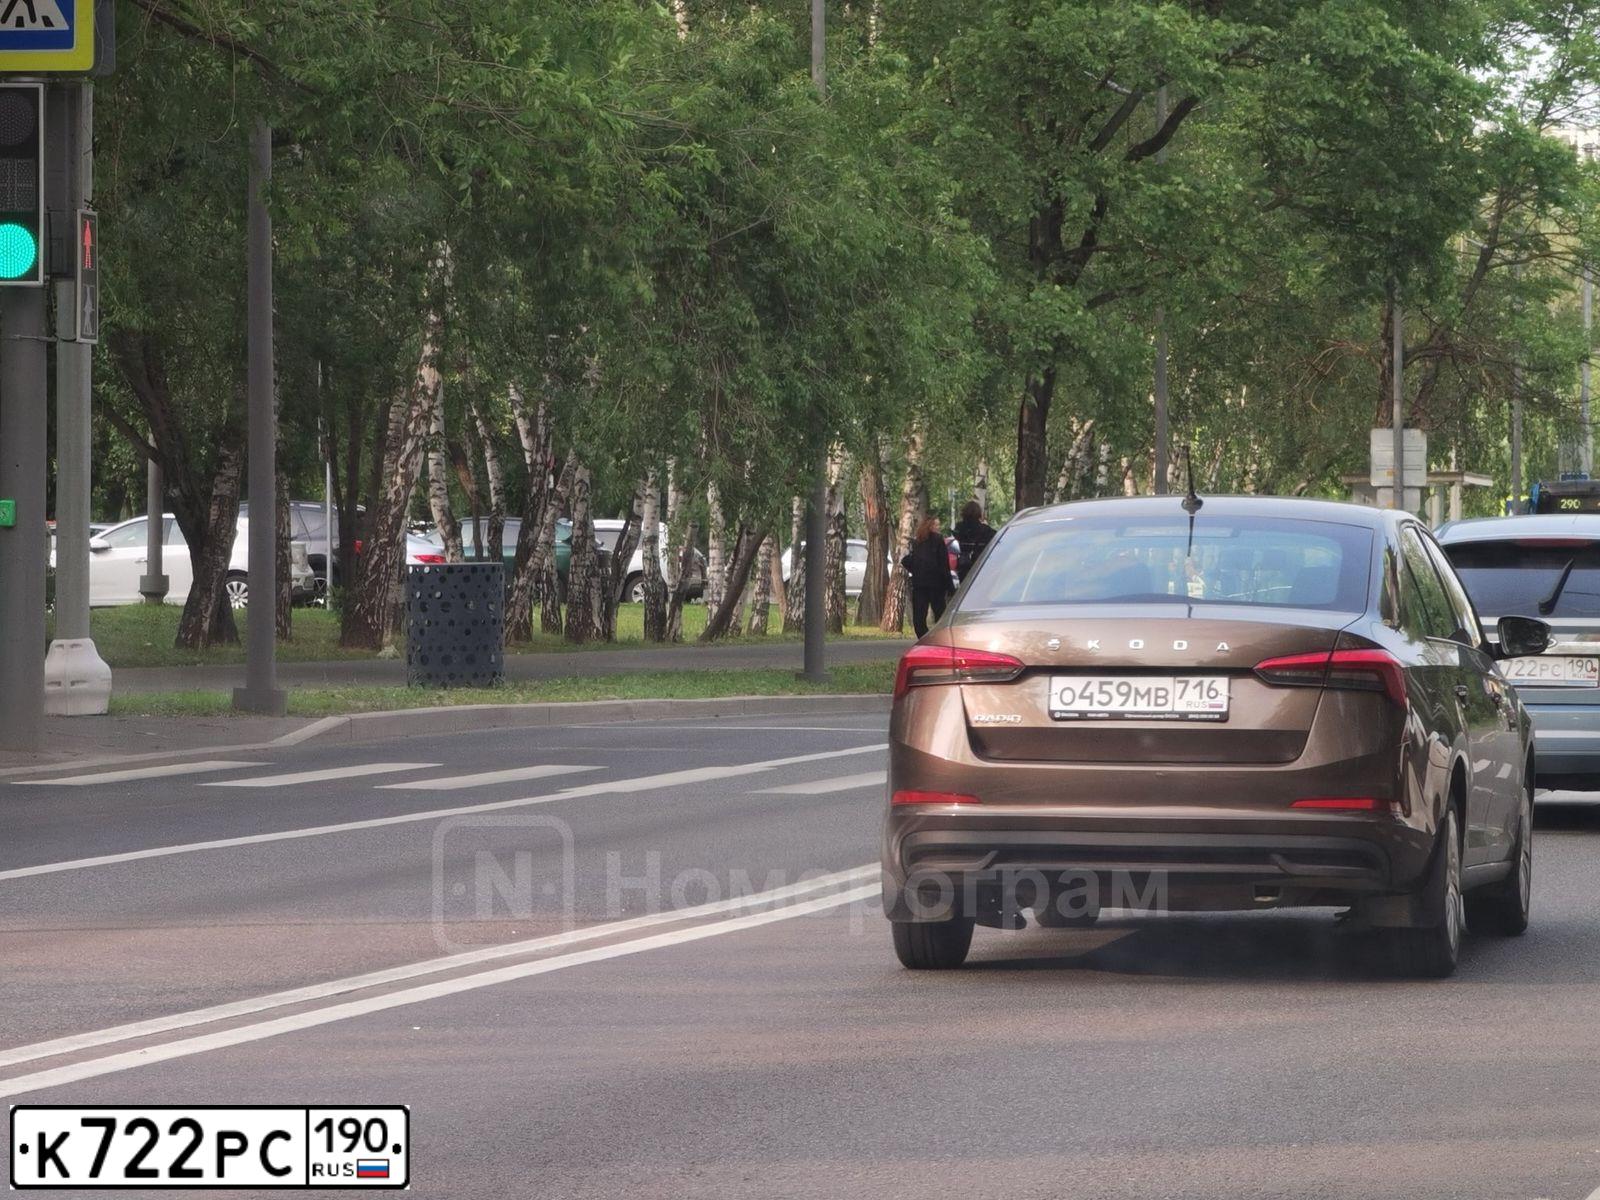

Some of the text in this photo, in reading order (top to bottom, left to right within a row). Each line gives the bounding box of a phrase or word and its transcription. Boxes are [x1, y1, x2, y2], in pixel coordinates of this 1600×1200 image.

[1560, 498, 1580, 509] 290
[1502, 659, 1593, 678] 722РС 190
[1059, 679, 1219, 708] О459МВ 716
[1186, 701, 1207, 709] RUS
